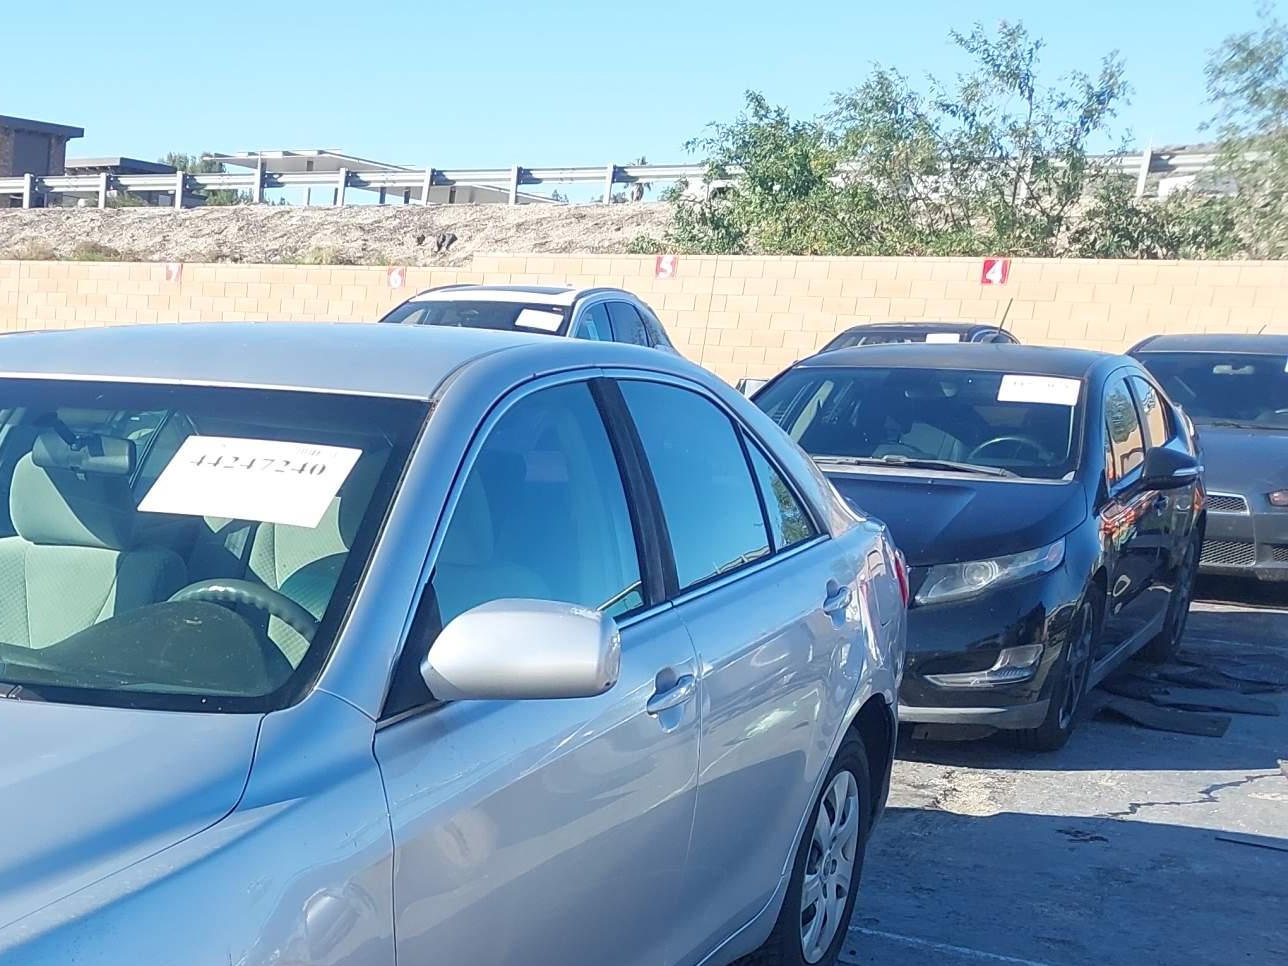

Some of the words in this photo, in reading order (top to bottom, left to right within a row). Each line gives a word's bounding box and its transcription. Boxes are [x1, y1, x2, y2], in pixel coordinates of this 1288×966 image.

[659, 255, 674, 278] 5
[985, 259, 1003, 284] 4
[390, 267, 403, 289] 6
[190, 454, 327, 476] 44247240
